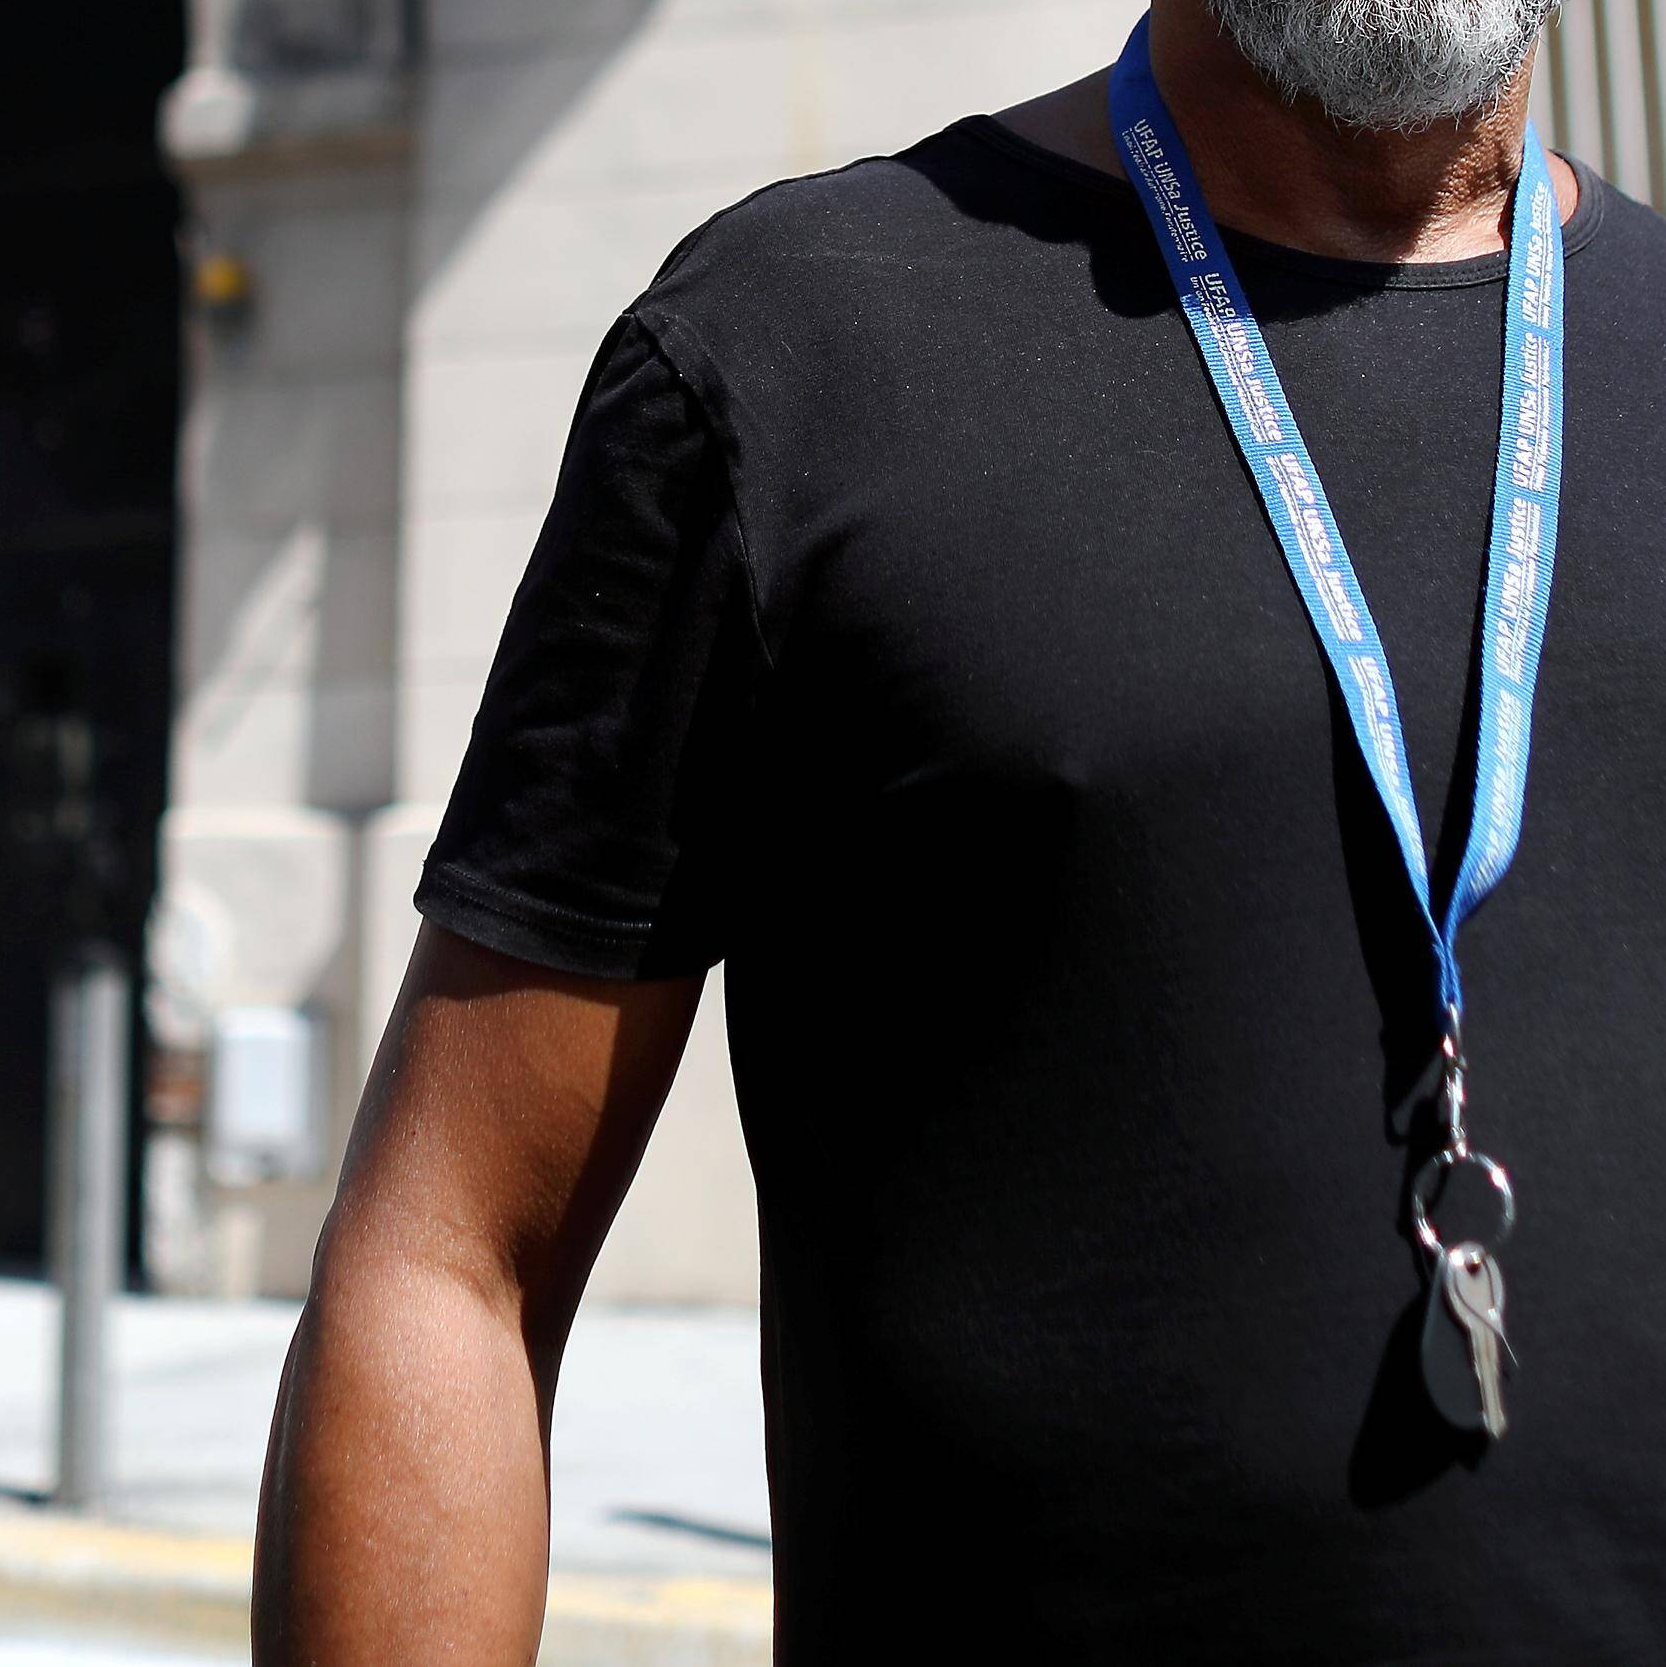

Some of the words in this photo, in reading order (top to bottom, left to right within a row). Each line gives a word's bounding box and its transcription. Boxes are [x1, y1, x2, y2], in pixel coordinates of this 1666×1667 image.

[1134, 118, 1164, 159] UFAP
[1173, 204, 1209, 261] Justice
[1522, 278, 1539, 324] UFAP
[1204, 272, 1237, 318] UFAP
[1245, 377, 1283, 441] Justice
[1280, 452, 1315, 505] UFAP
[1511, 437, 1534, 490] UFAP
[1505, 496, 1528, 560] Justice
